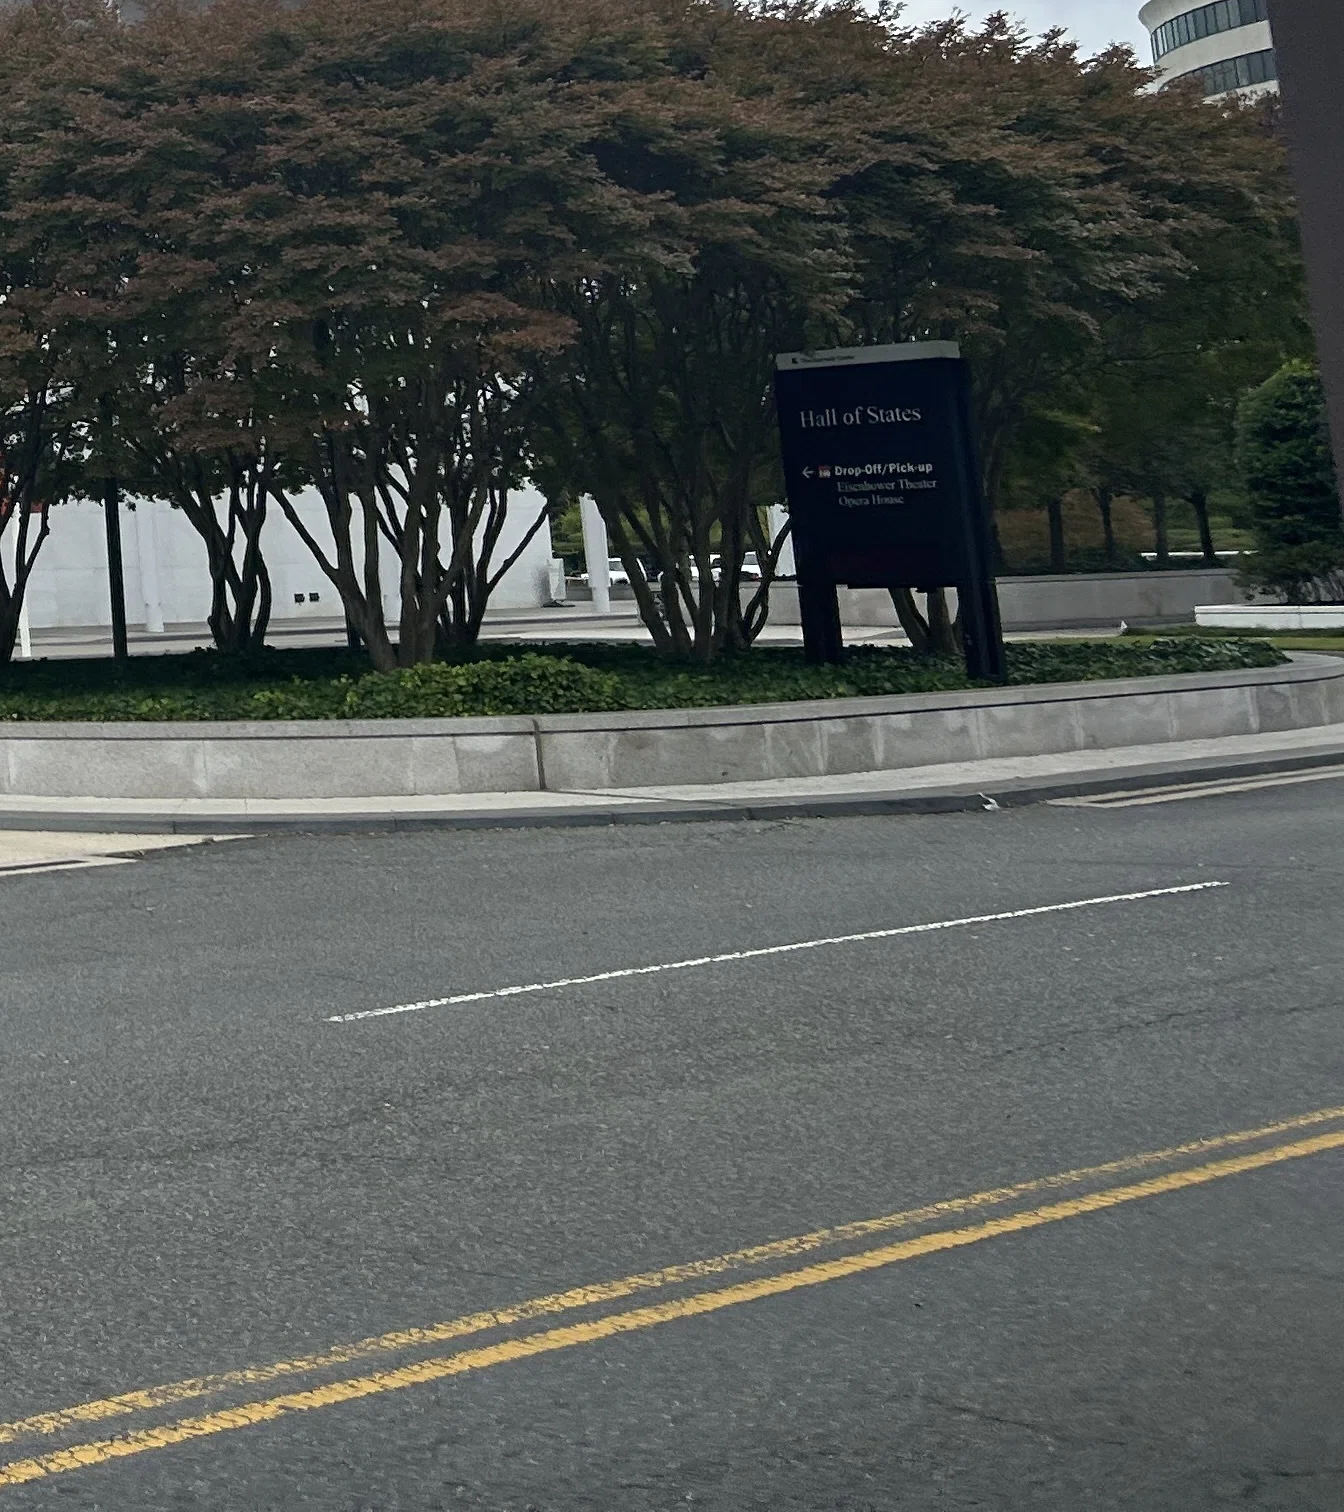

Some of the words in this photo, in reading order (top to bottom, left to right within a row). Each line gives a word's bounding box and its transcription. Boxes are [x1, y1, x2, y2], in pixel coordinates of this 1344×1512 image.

[800, 408, 838, 428] Hall
[843, 406, 863, 426] of
[867, 405, 922, 424] States
